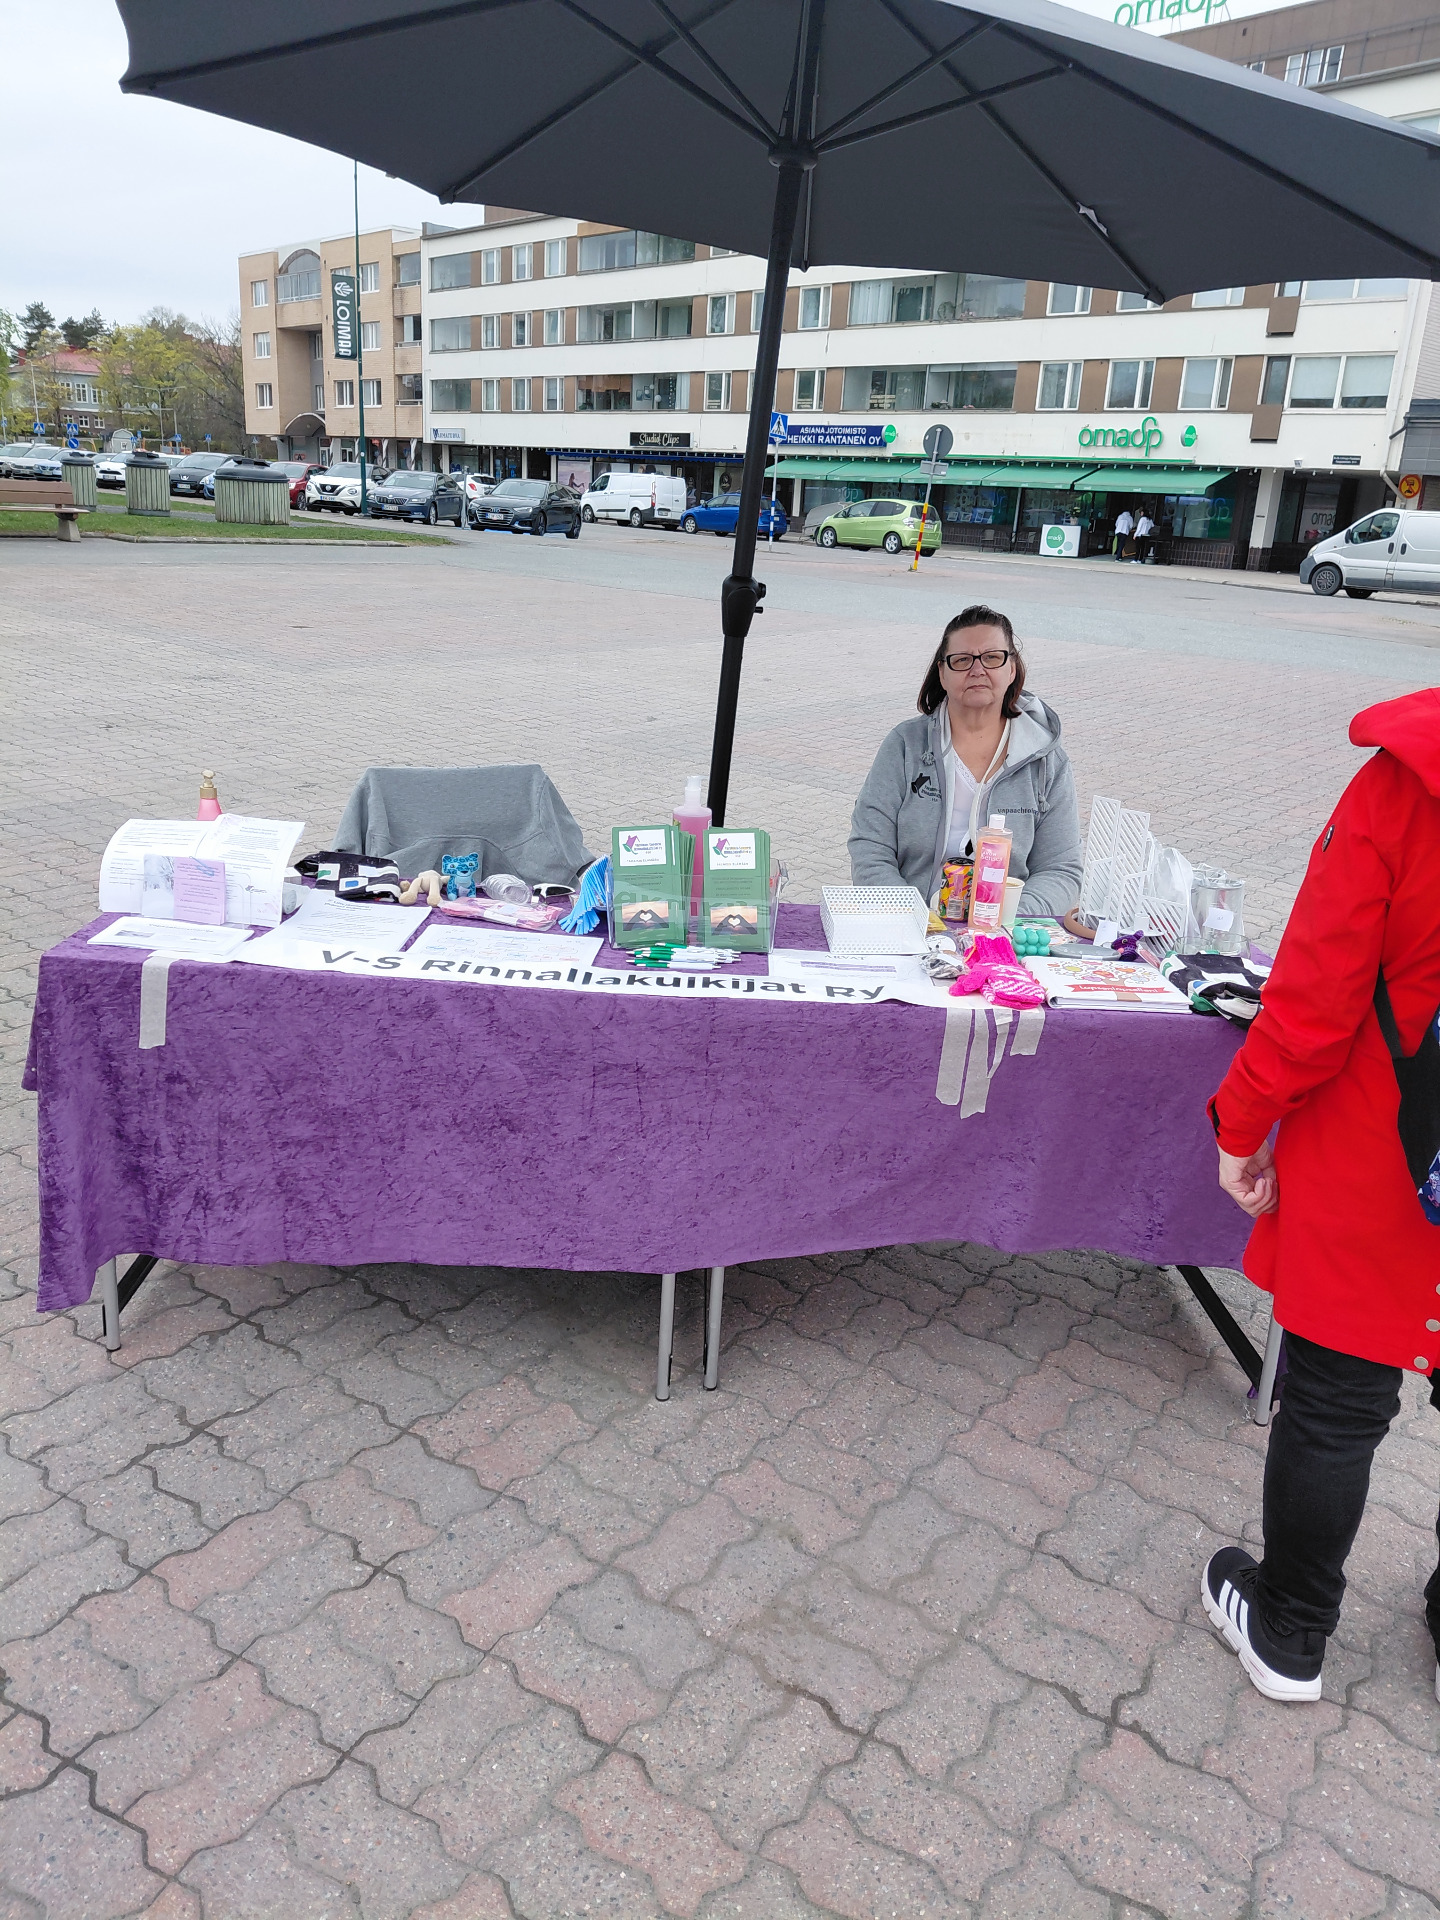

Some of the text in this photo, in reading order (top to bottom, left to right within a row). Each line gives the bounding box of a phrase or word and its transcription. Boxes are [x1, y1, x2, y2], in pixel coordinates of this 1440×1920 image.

[336, 299, 352, 357] LOIMAA
[800, 426, 867, 435] ASIANAJOTOIMISTO
[662, 433, 680, 447] Clips
[787, 434, 881, 446] HEIKKI RANTANEN OY
[322, 950, 405, 970] V-S
[420, 959, 807, 994] Rinnallakulkijat
[825, 984, 885, 1000] Ry
